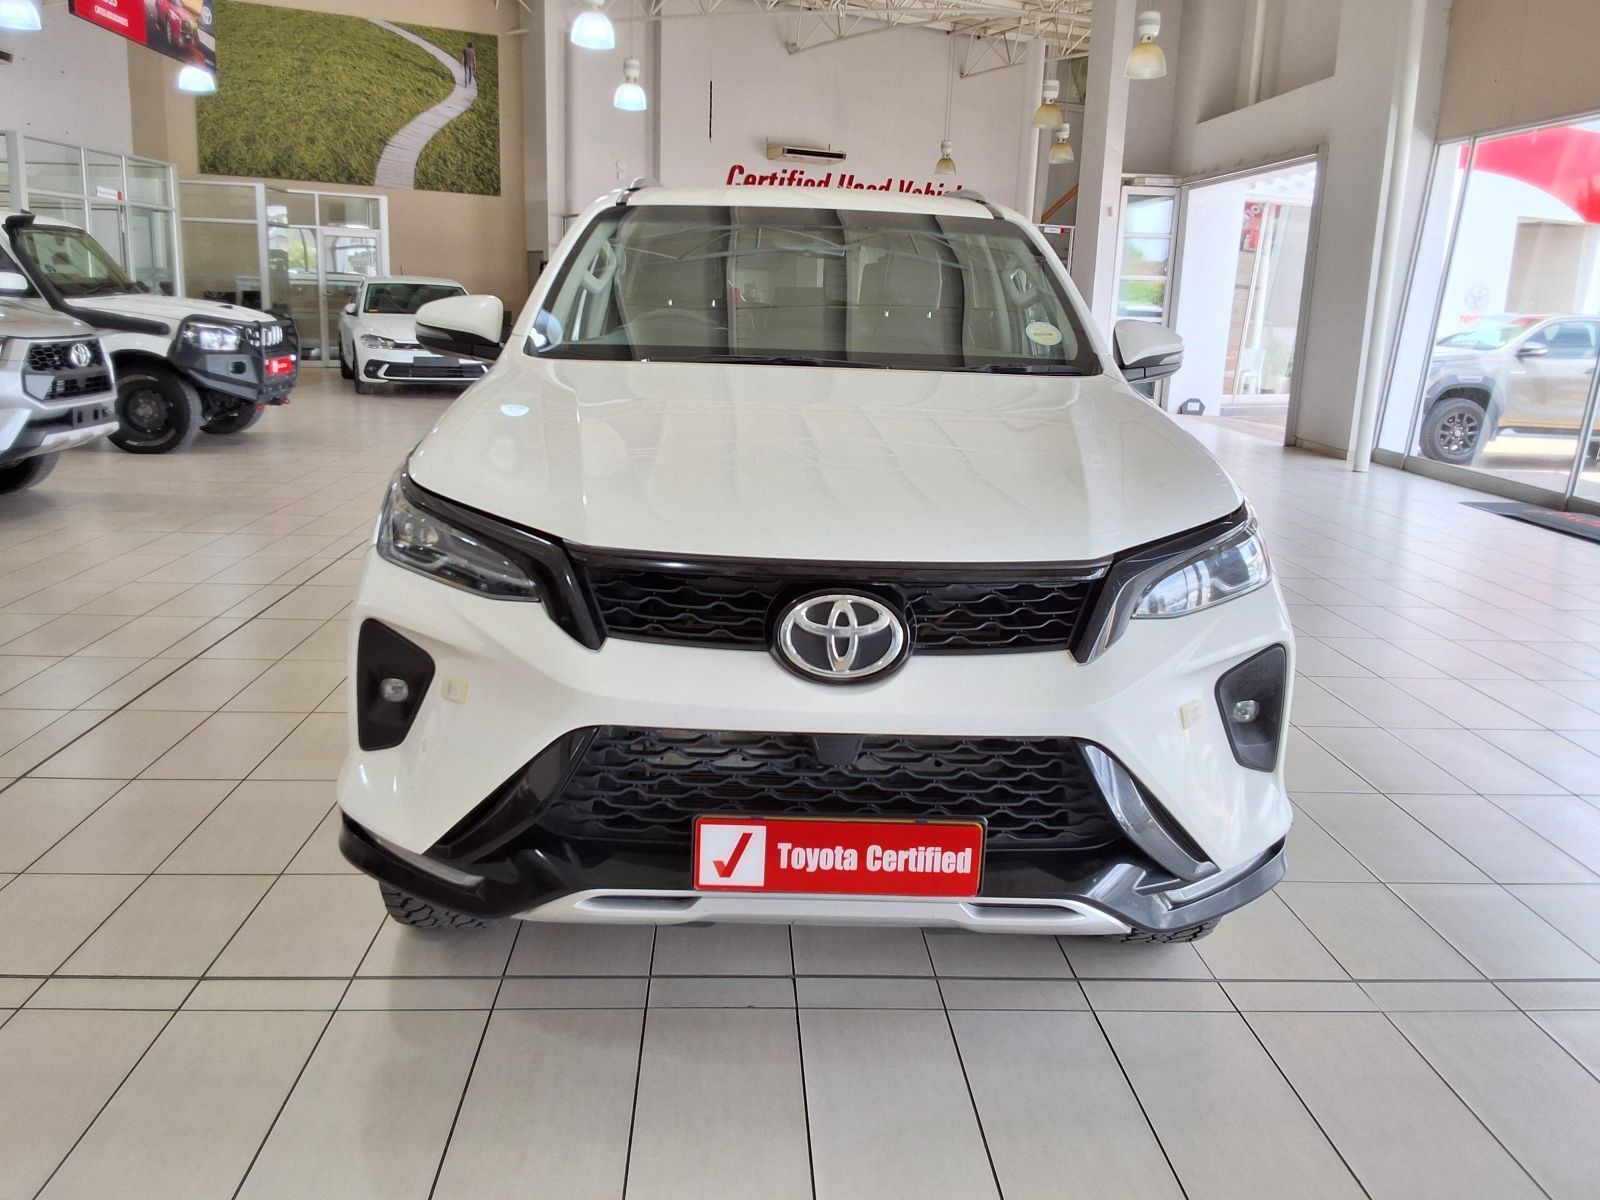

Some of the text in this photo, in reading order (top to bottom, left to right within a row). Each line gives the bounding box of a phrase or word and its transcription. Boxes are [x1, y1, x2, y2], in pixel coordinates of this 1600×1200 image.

[837, 173, 893, 192] Ud
[777, 842, 972, 874] Toyota Certified
